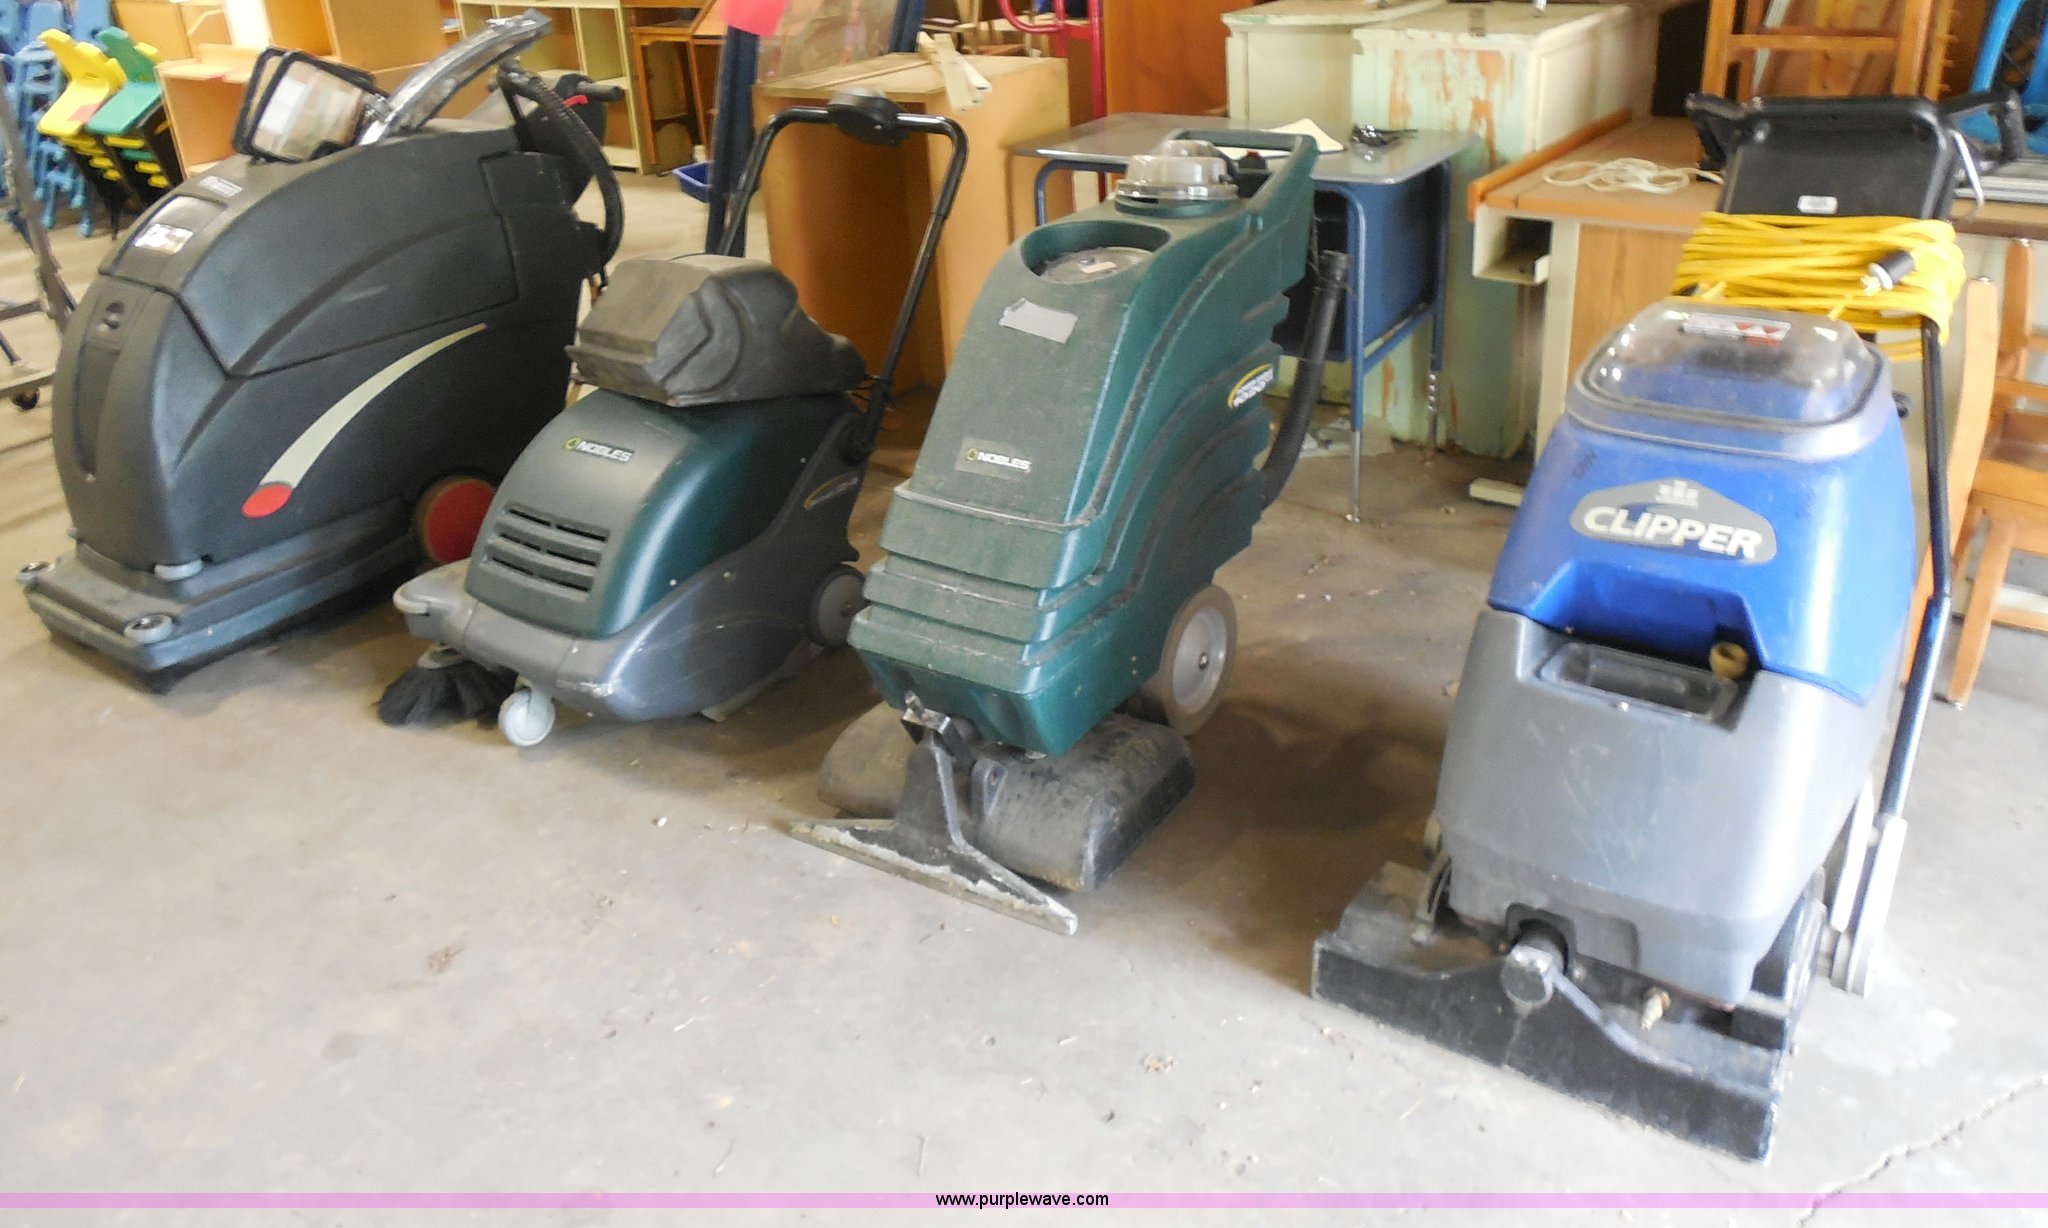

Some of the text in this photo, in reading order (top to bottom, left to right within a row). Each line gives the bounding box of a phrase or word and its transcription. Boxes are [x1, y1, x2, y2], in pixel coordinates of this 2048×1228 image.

[576, 440, 633, 462] NOBLES
[977, 451, 1032, 471] NOBLES
[1584, 506, 1763, 560] CLIPPER
